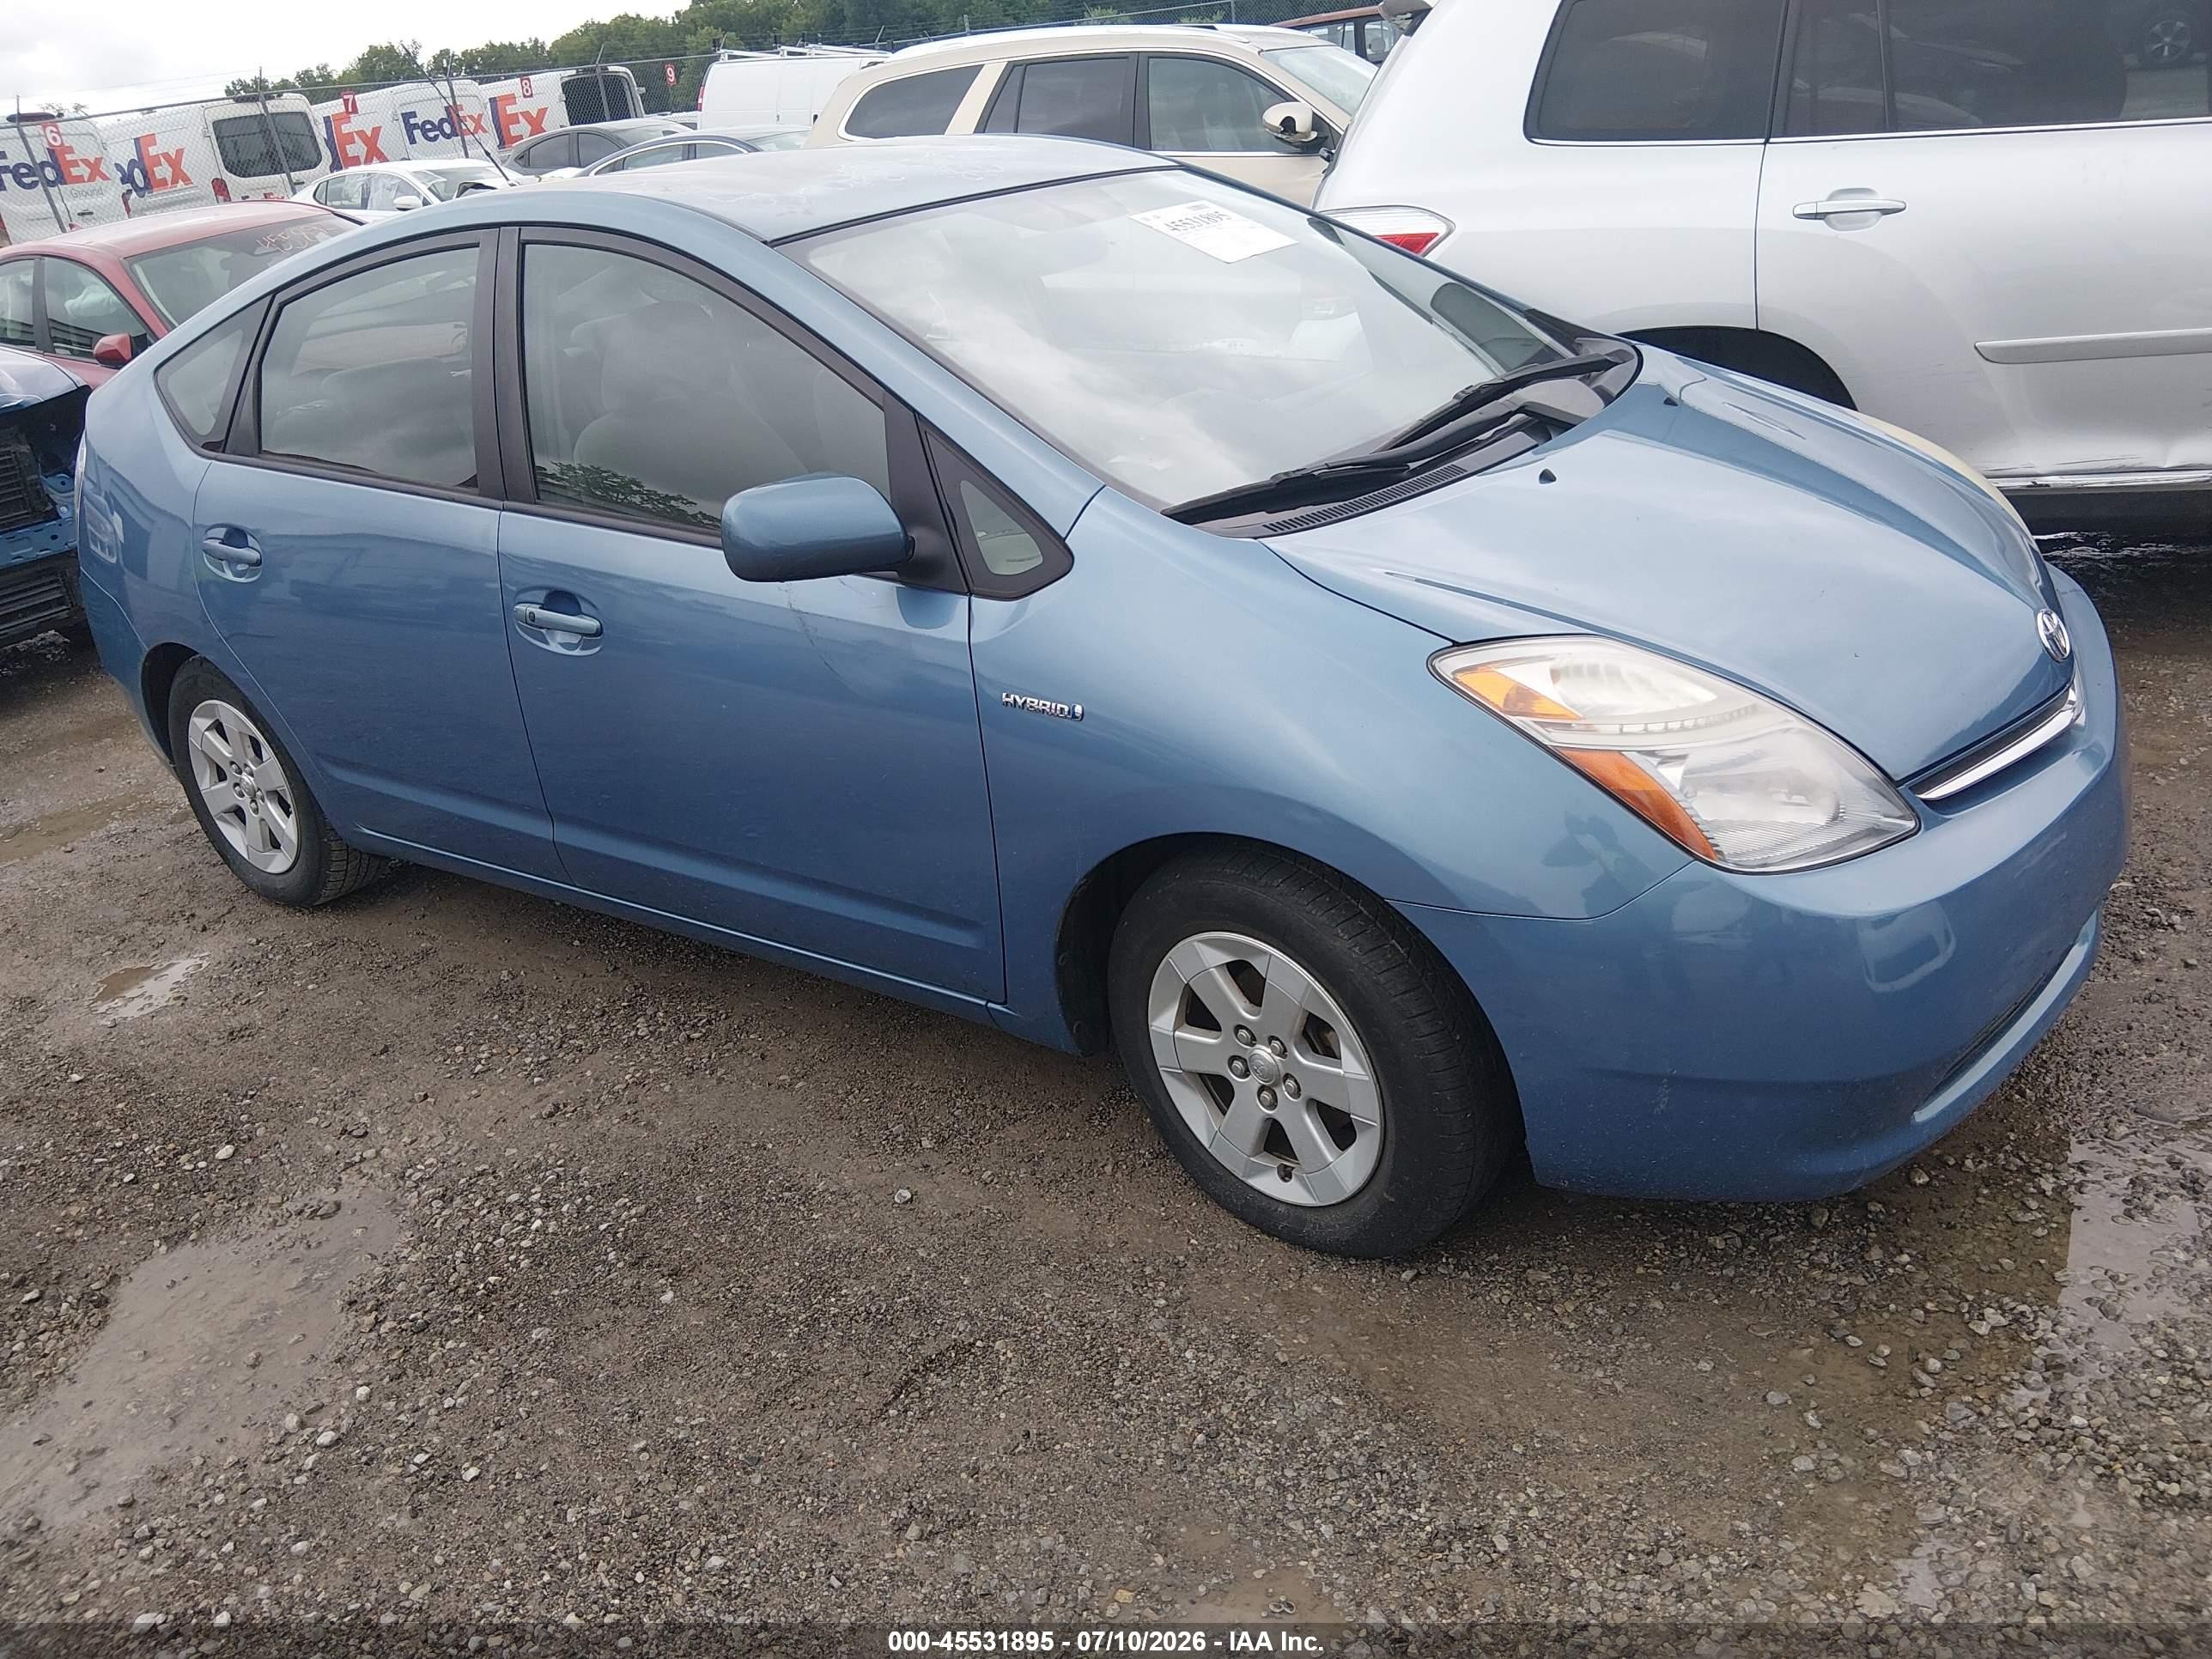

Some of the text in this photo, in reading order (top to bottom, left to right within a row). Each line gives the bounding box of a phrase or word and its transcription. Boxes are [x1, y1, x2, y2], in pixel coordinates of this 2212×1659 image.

[666, 67, 675, 82] 9
[521, 78, 532, 96] 8
[343, 94, 355, 112] 7
[401, 104, 488, 145] FedEx
[46, 125, 62, 146] 6
[1002, 692, 1070, 718] HYBRID
